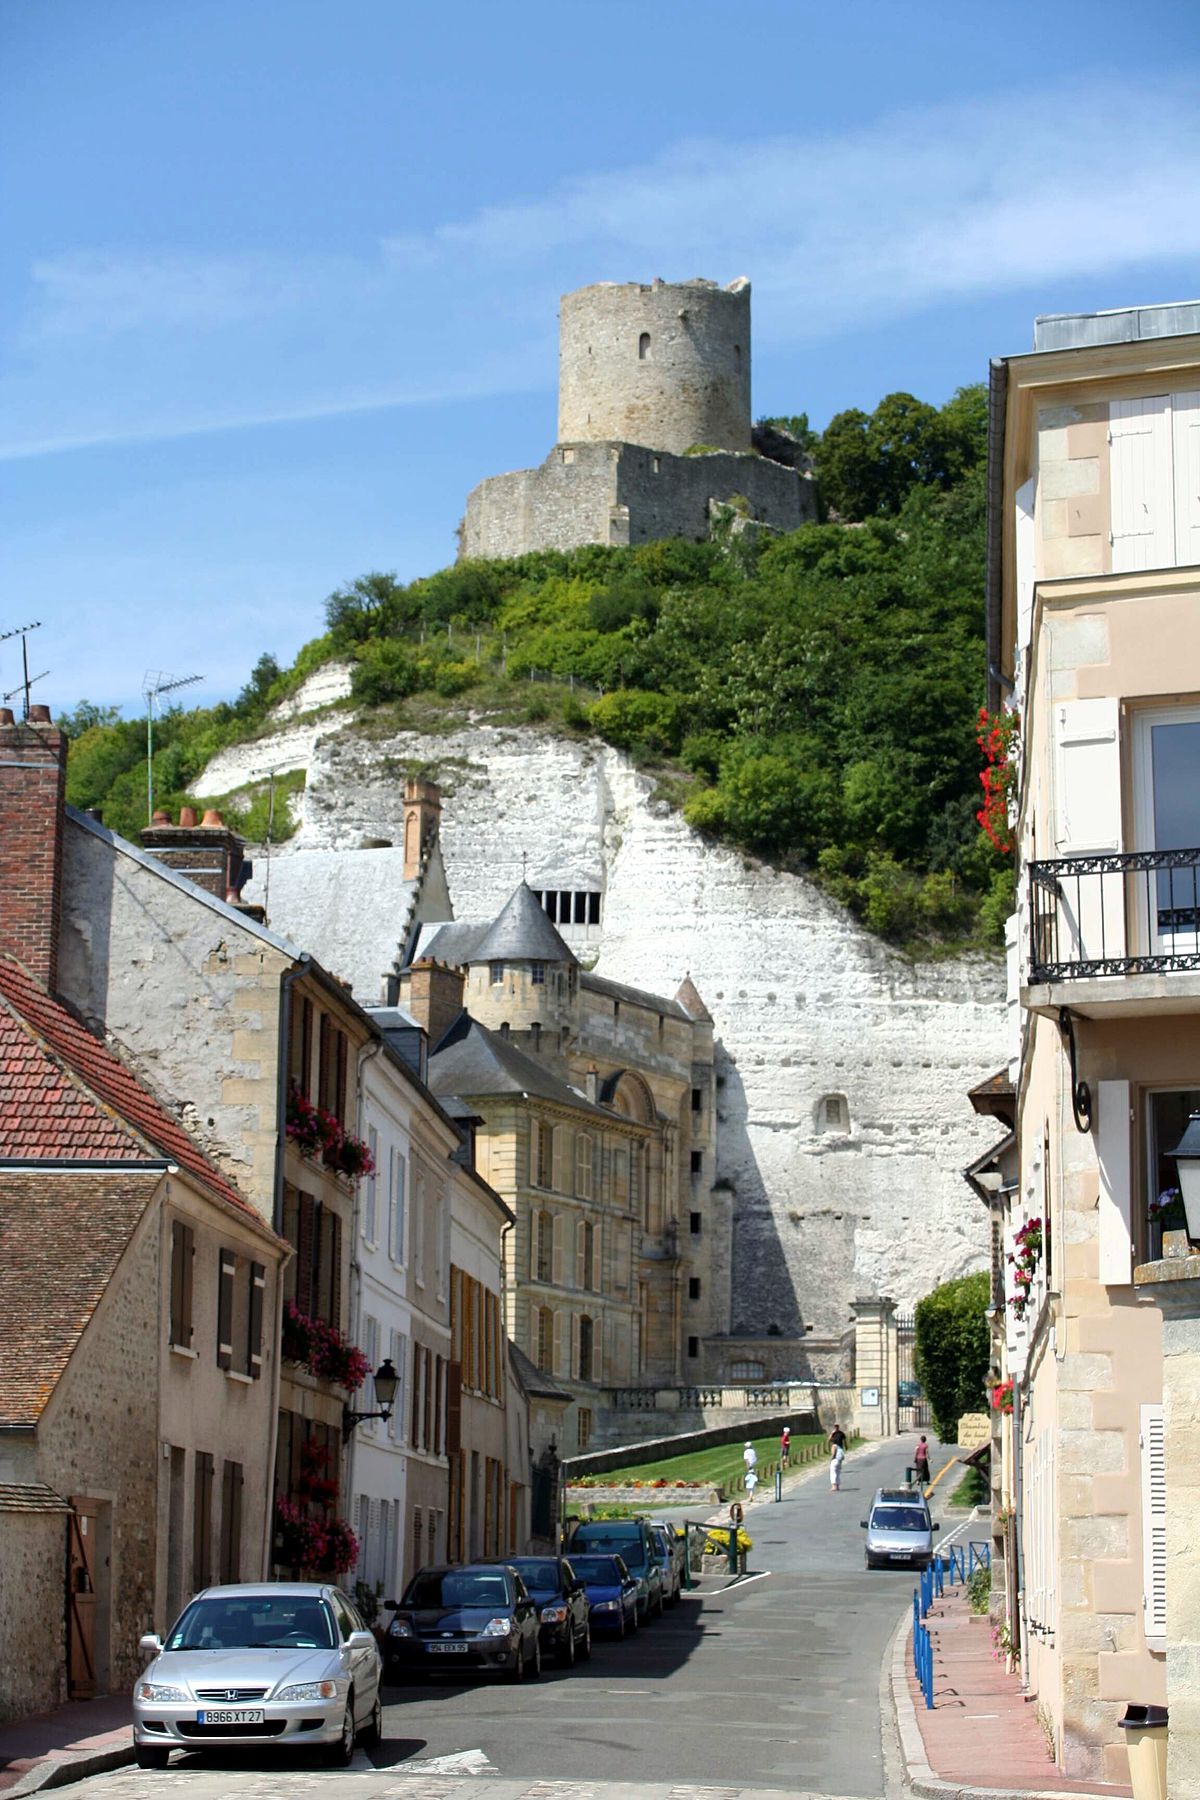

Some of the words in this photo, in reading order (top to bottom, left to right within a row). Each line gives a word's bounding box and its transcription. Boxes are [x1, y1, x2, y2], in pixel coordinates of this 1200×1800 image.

[207, 1712, 232, 1722] 8966
[234, 1712, 246, 1722] XT
[248, 1711, 261, 1721] 27
